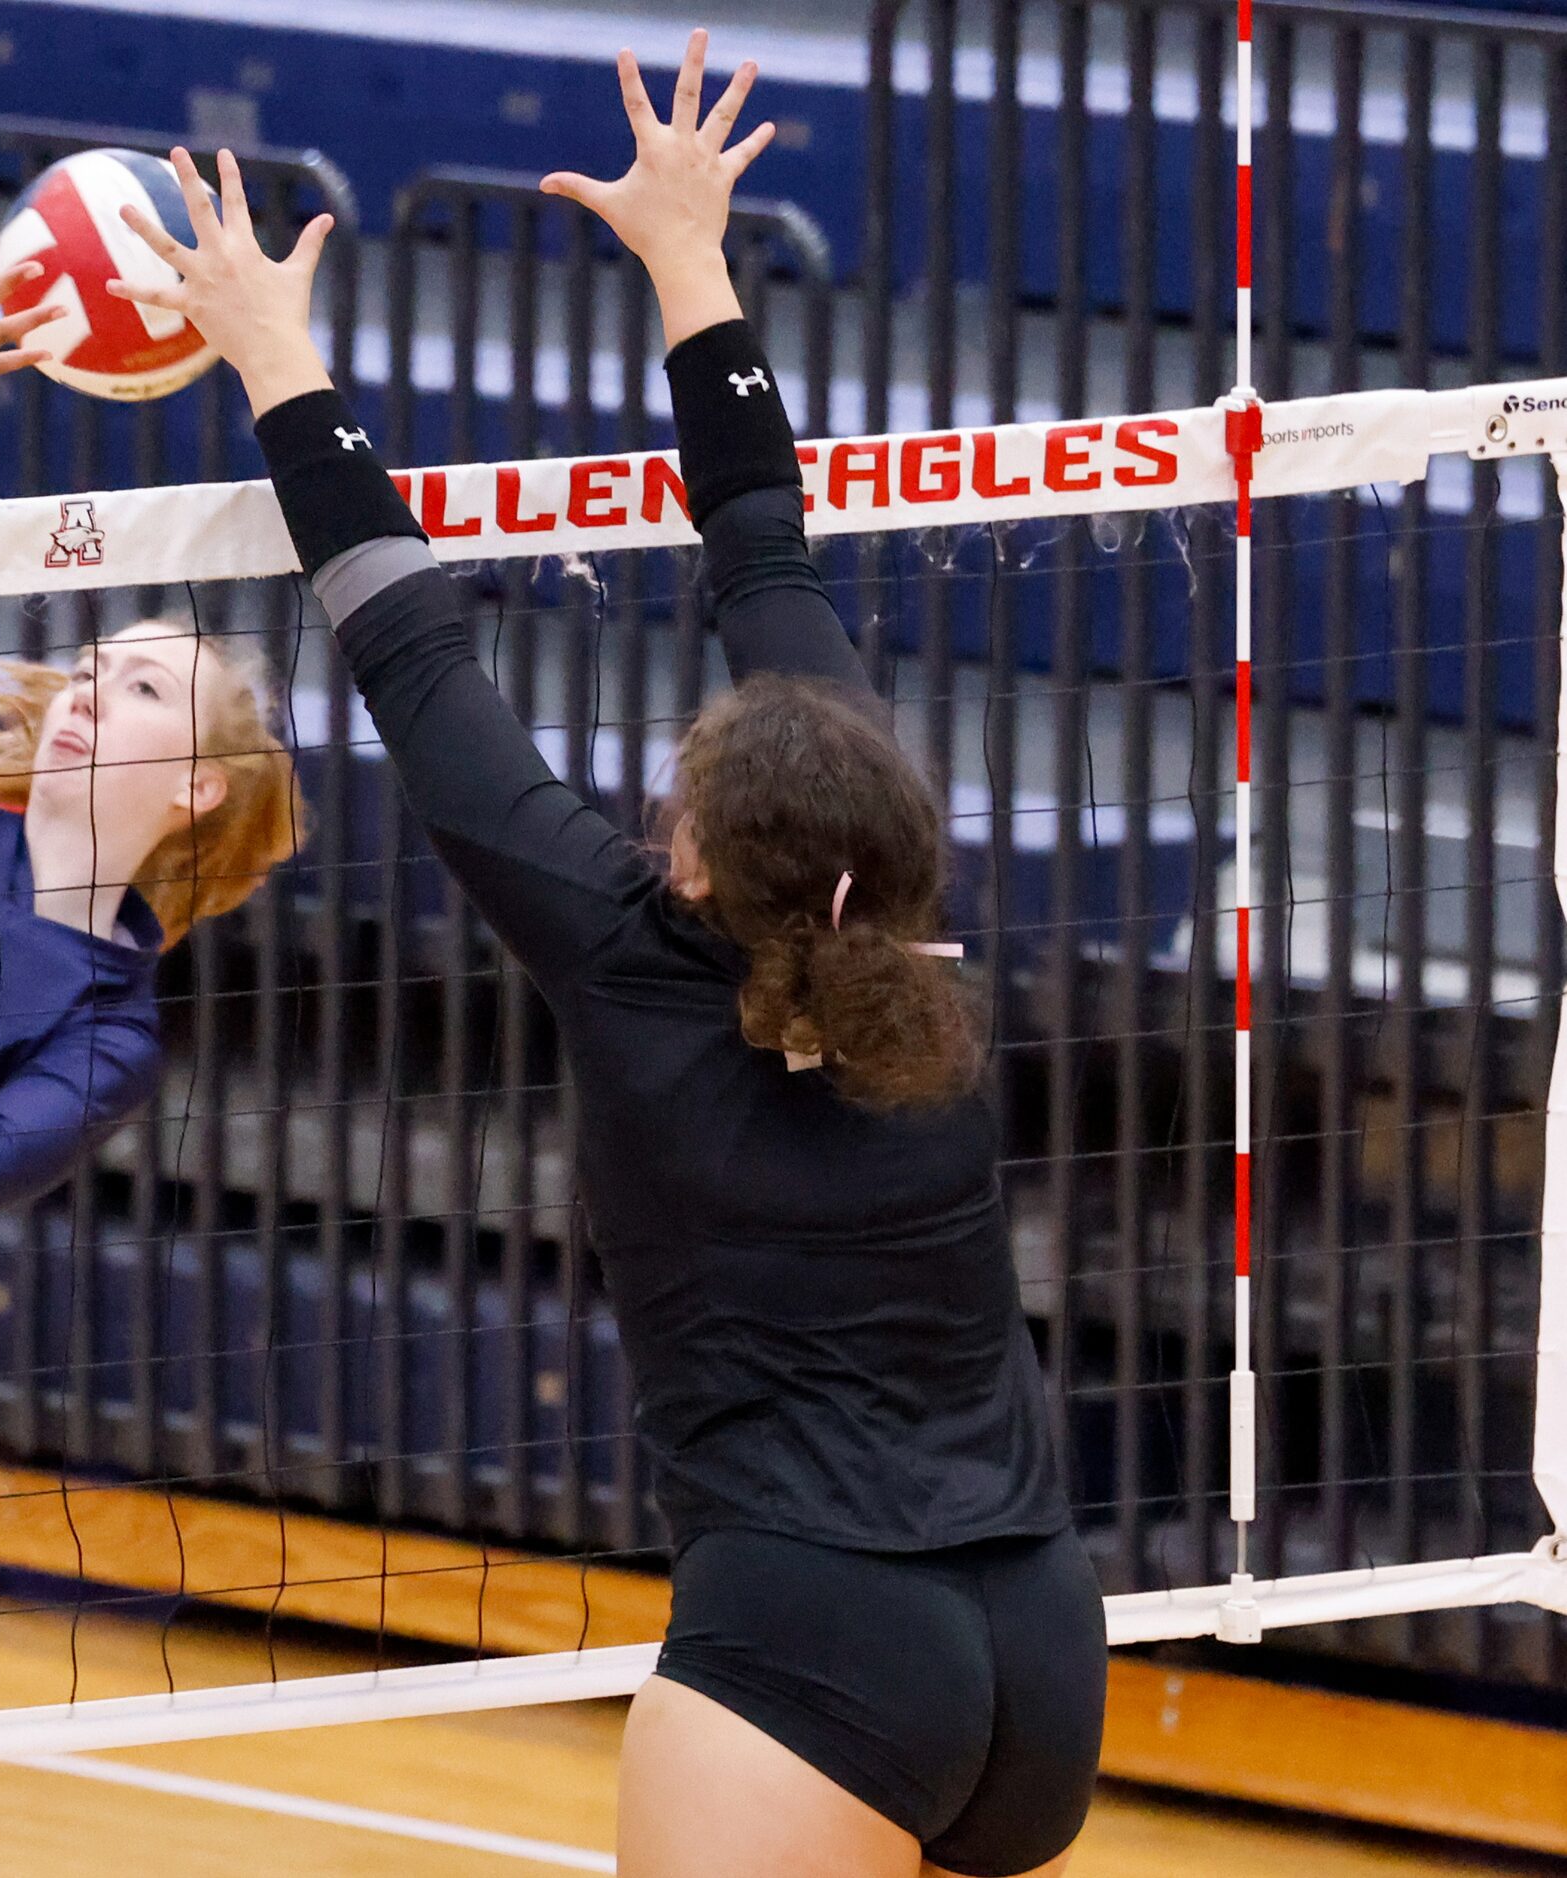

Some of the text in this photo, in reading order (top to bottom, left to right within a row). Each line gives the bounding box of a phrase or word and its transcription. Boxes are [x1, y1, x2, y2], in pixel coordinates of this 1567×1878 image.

[1261, 421, 1354, 448] ports imports
[390, 456, 695, 538] LLEN
